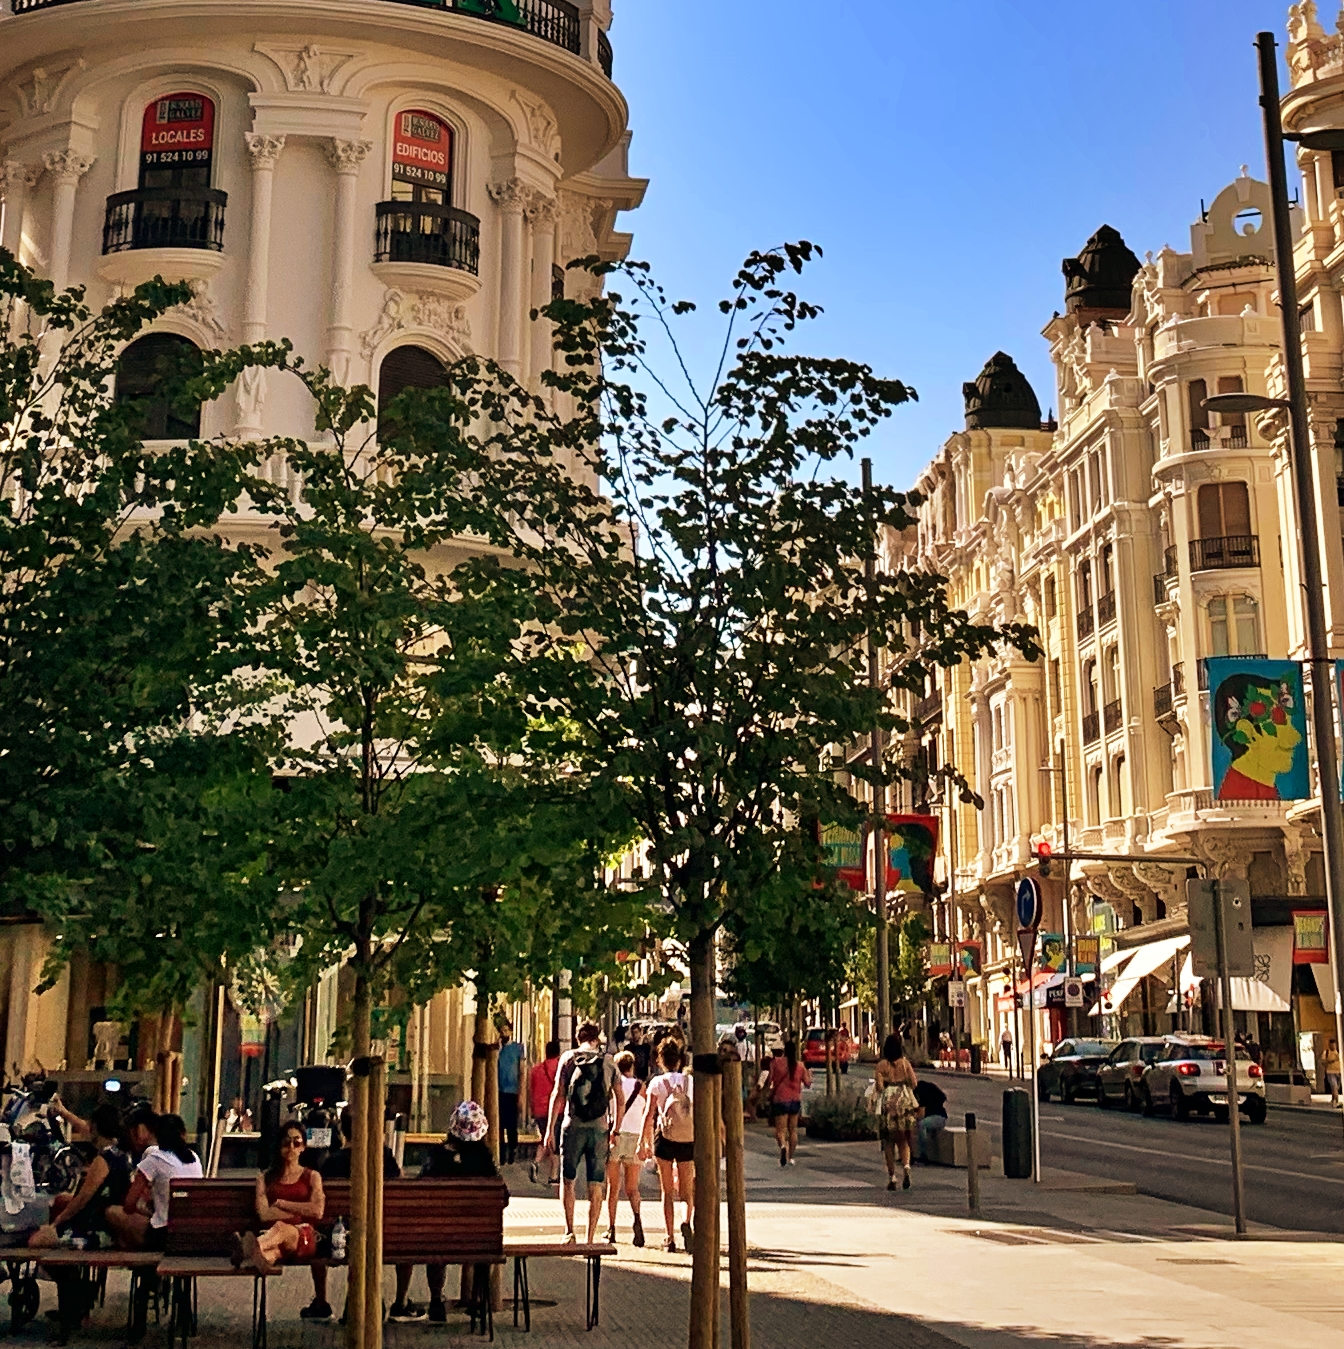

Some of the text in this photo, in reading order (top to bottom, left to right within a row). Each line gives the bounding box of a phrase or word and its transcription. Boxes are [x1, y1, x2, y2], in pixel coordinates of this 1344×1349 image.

[151, 128, 205, 145] LOCALES
[145, 149, 209, 164] 91 524 10 99
[396, 142, 445, 165] EDIFICIOS
[393, 163, 446, 184] 91 524 10 99
